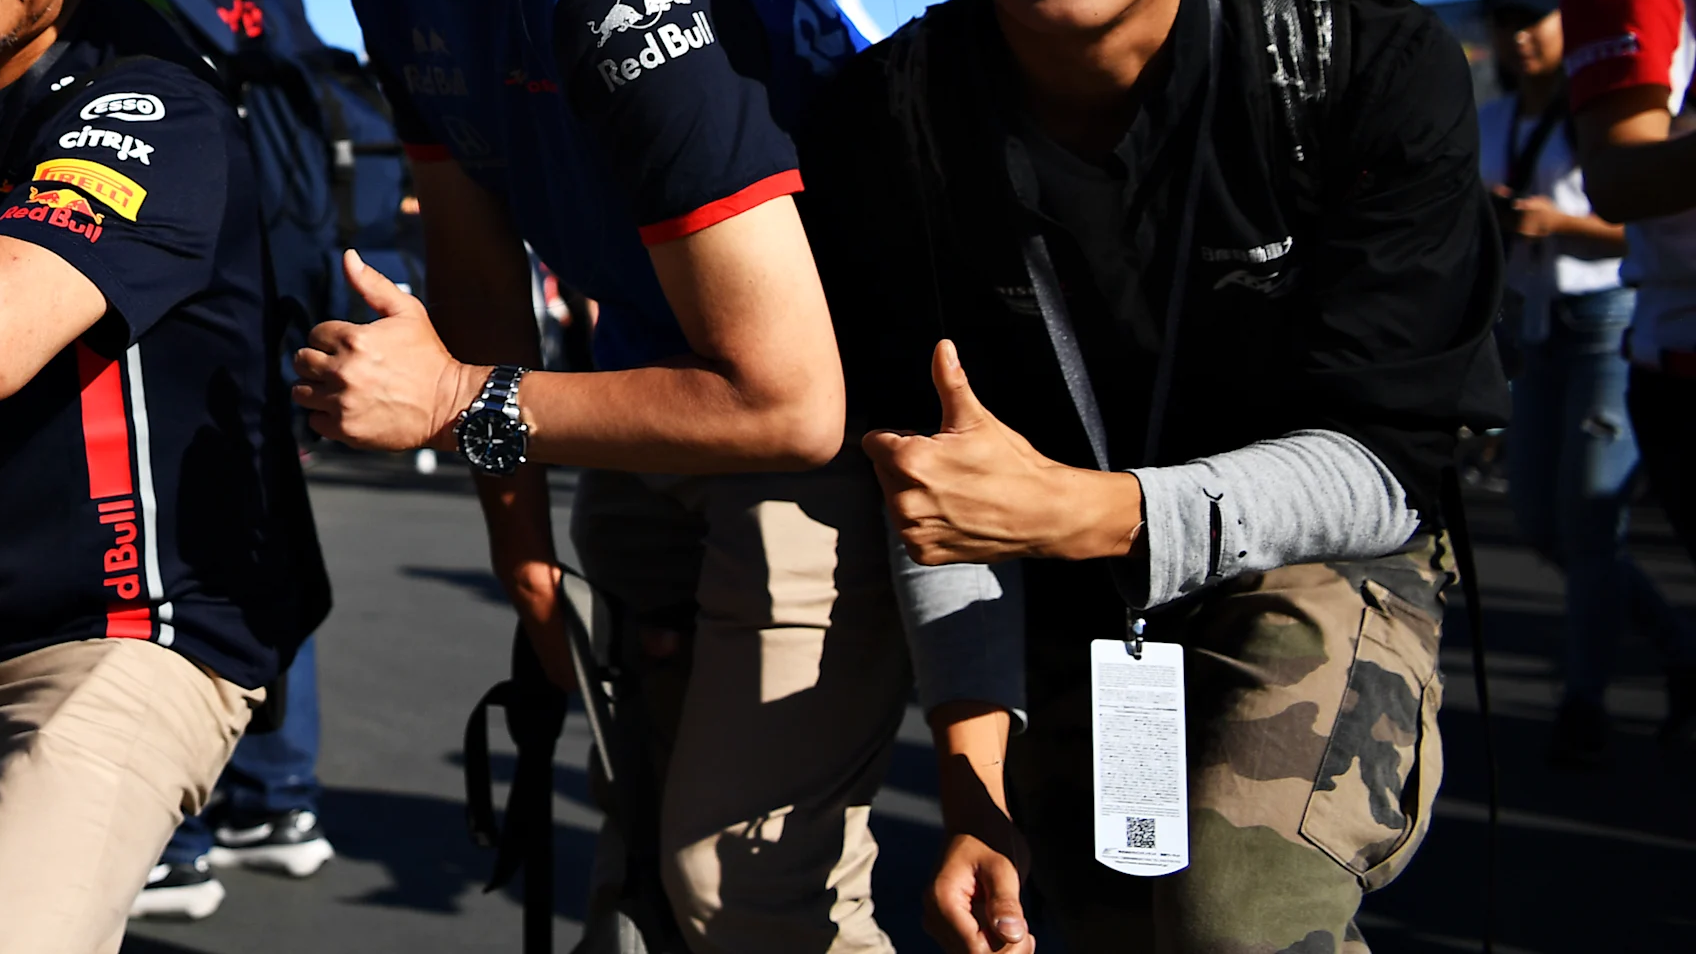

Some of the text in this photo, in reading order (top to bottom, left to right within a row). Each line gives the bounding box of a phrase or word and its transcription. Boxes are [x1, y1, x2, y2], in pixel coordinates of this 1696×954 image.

[596, 31, 666, 93] Red
[659, 10, 716, 59] Bull
[39, 167, 135, 209] PIRELLI
[47, 206, 104, 244] Bull
[97, 499, 140, 573] Bull
